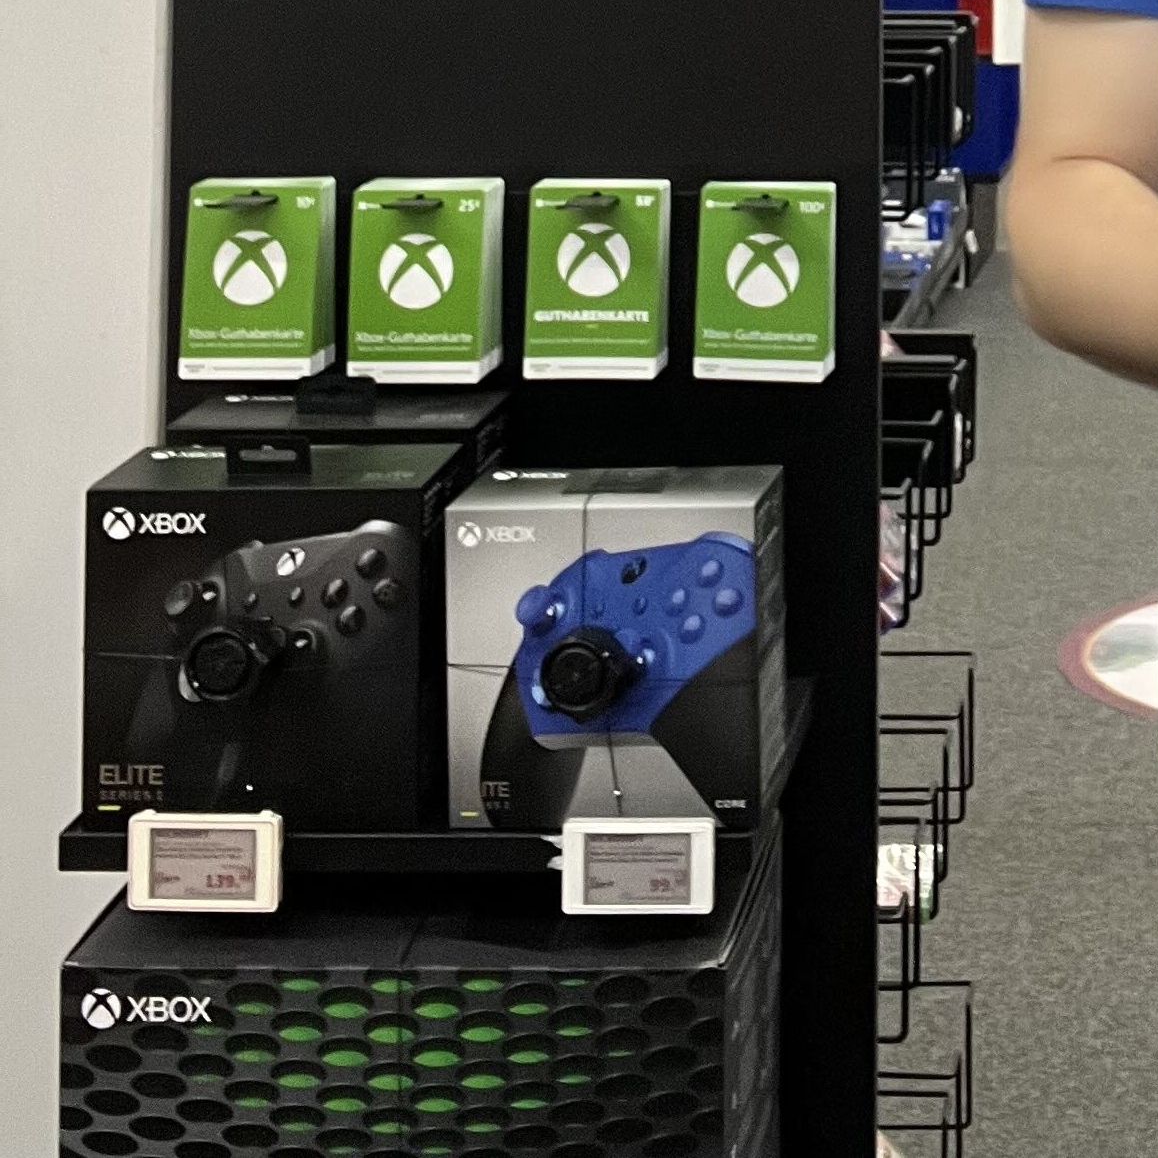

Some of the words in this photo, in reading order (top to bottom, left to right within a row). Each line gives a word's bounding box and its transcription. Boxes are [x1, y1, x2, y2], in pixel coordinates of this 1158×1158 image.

[138, 512, 207, 535] XBOX
[485, 525, 536, 543] XBOX
[100, 764, 165, 786] ELITE
[126, 995, 213, 1023] XBOX
